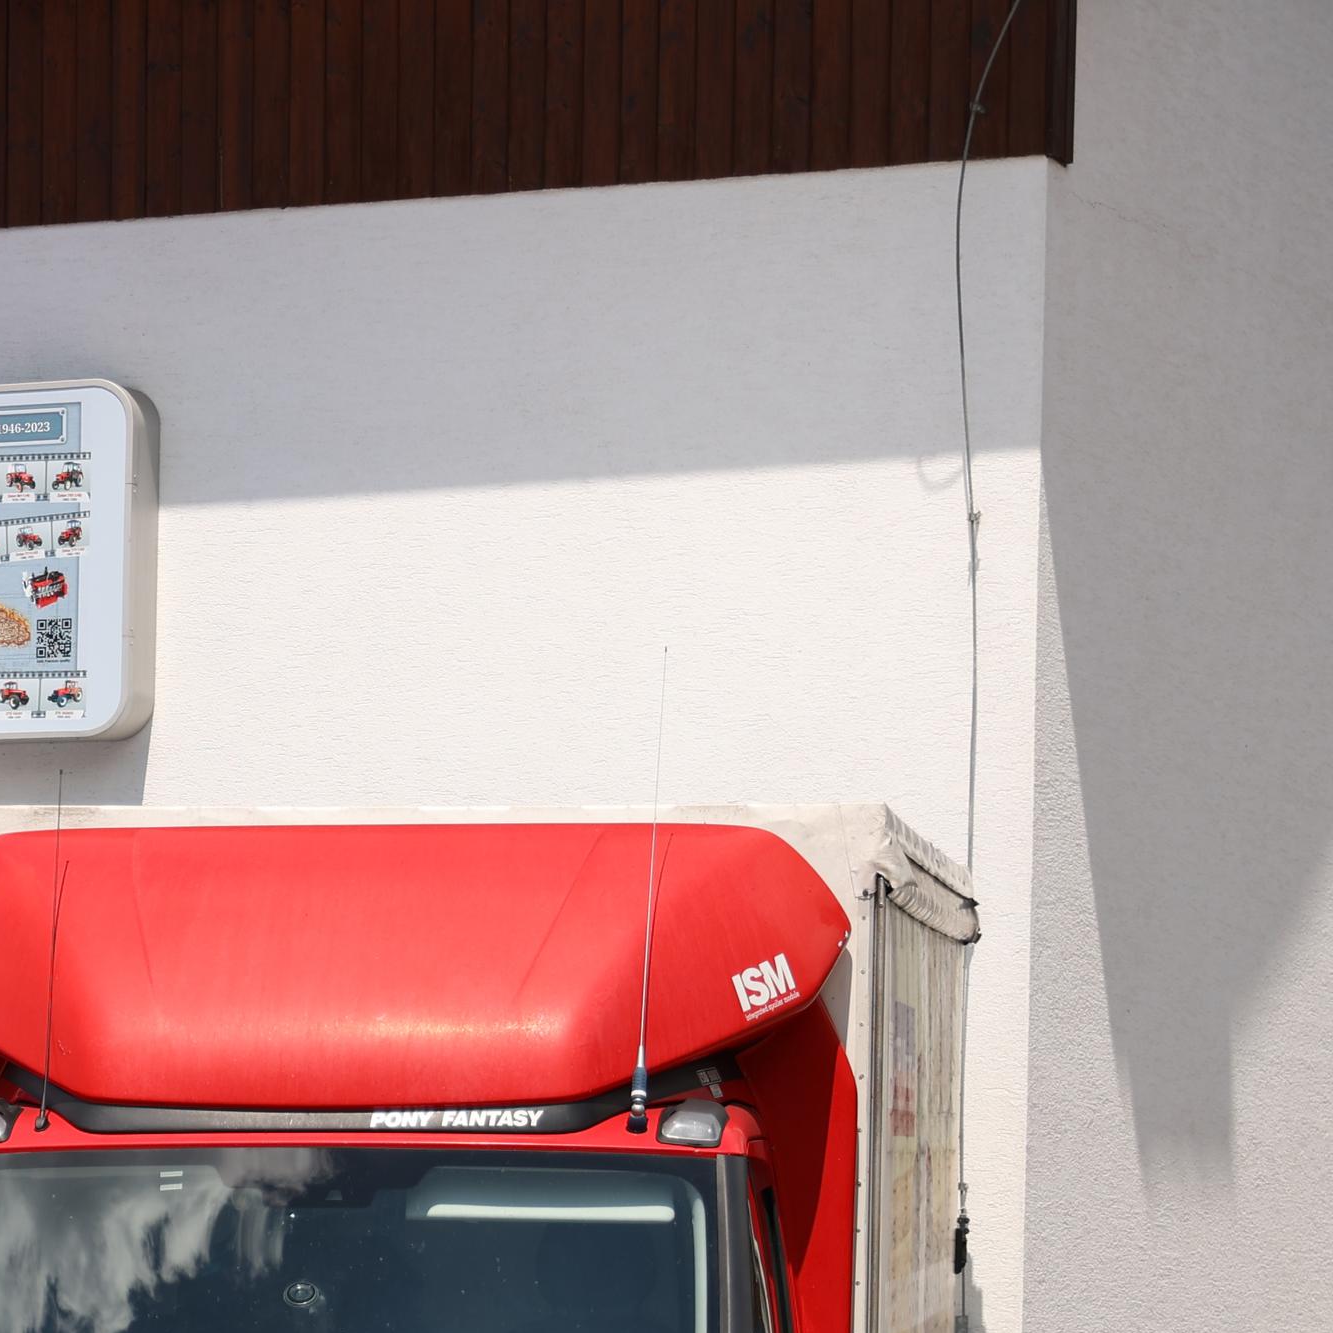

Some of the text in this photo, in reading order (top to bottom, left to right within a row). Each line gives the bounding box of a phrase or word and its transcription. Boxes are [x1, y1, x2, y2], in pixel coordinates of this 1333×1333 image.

[731, 952, 796, 1012] ISM
[369, 1110, 544, 1128] PONY FANTASY
